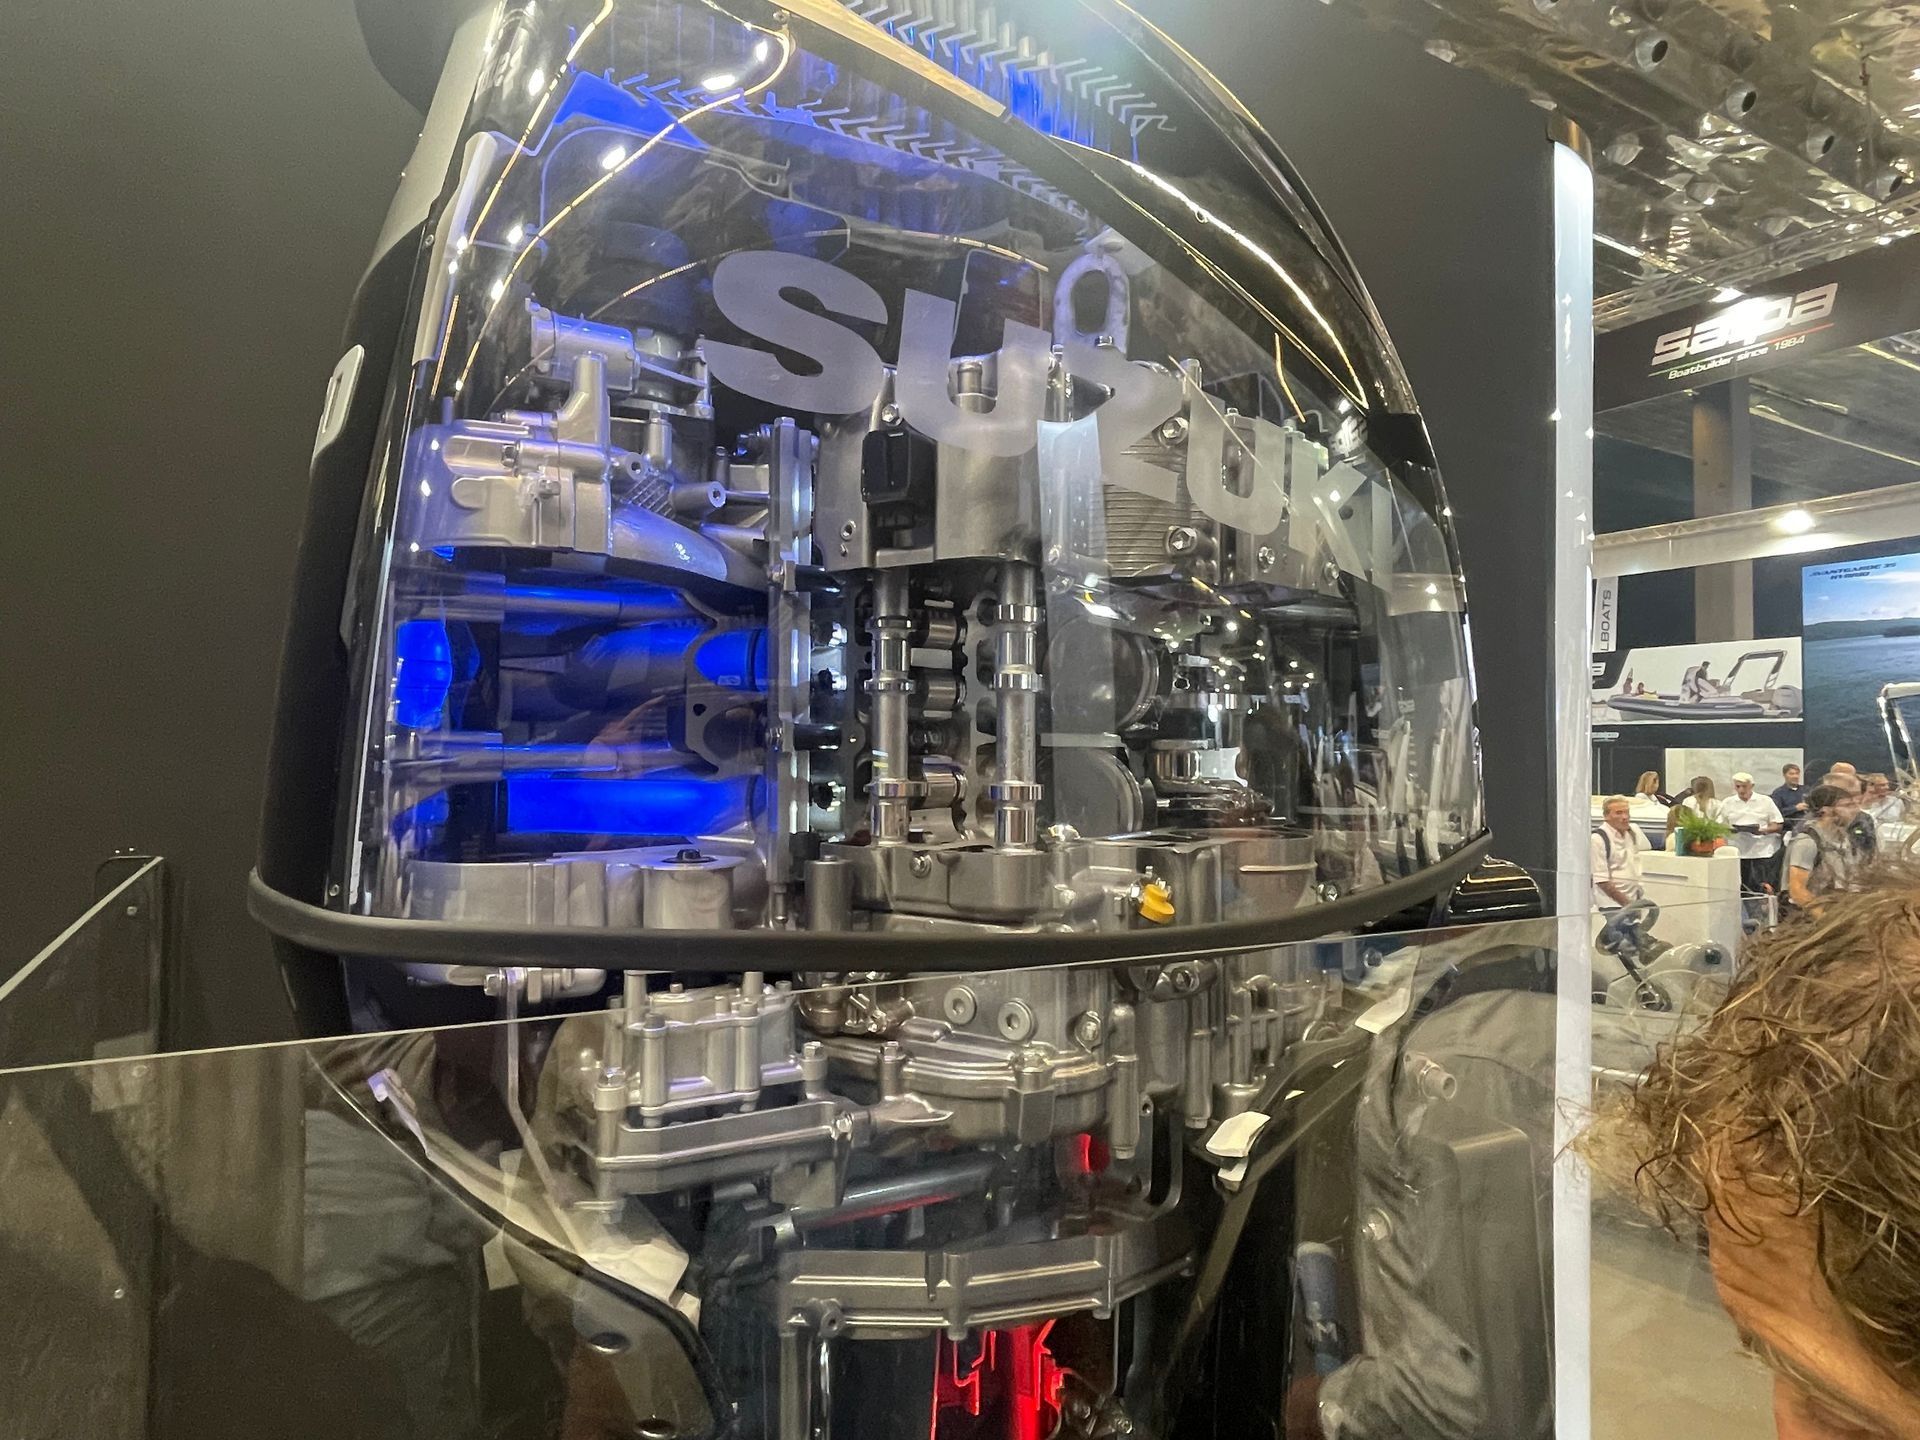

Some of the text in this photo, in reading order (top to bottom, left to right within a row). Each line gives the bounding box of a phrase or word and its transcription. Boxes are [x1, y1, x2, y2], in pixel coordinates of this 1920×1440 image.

[704, 250, 1393, 593] SUZUKI
[1668, 335, 1806, 379] Boatbuilder since 1984
